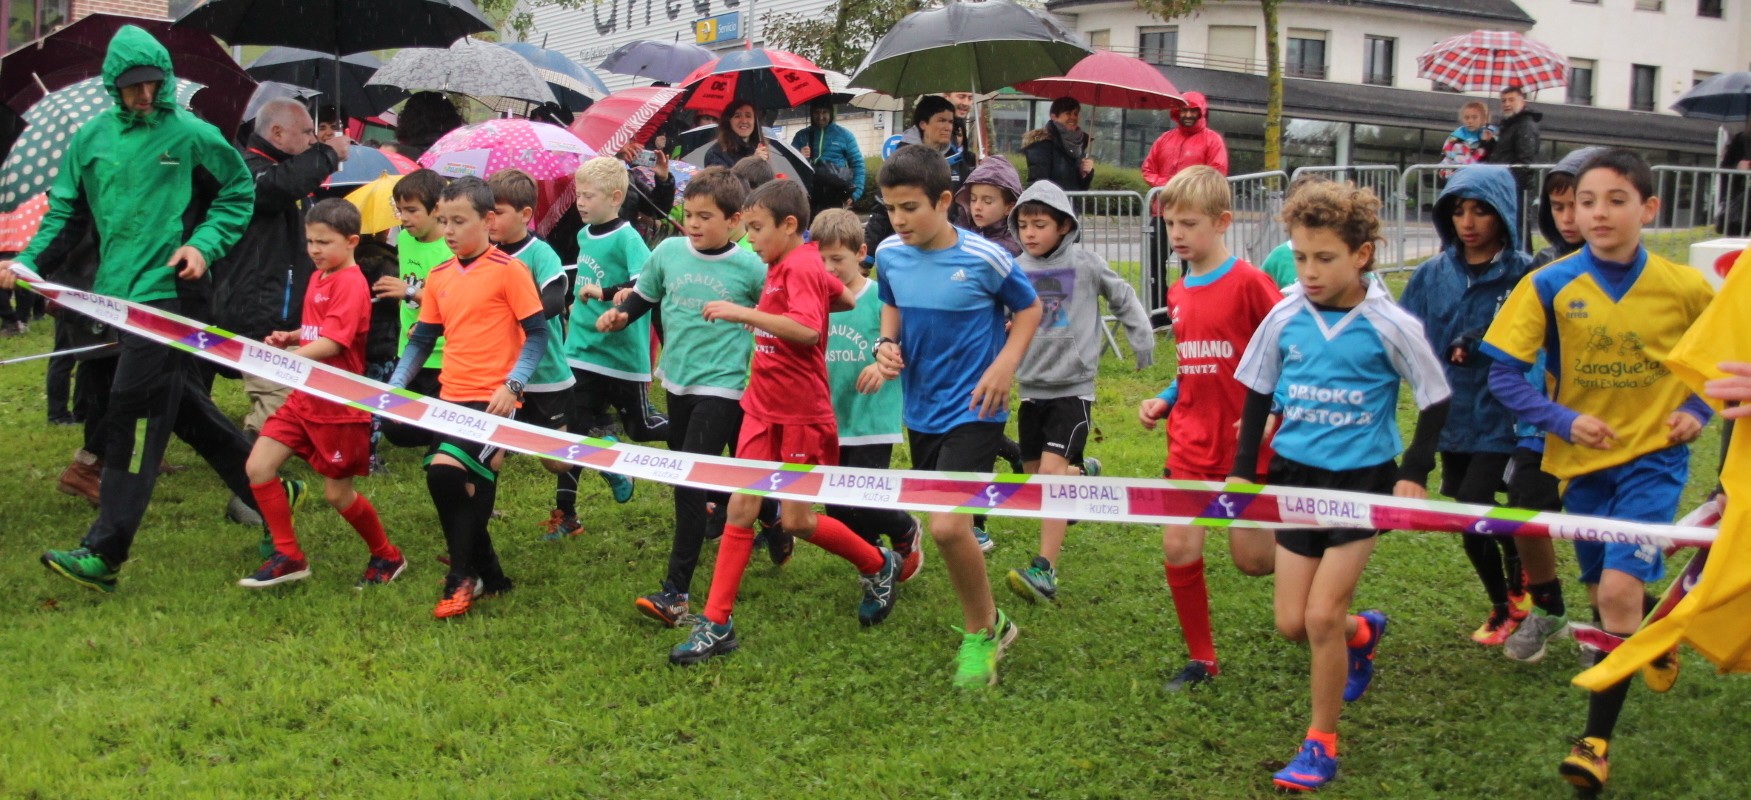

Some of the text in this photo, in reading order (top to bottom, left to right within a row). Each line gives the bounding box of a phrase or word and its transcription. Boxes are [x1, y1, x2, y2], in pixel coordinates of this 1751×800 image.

[718, 22, 737, 34] Servicio
[878, 113, 883, 123] 2
[828, 324, 868, 350] AUZKO
[248, 345, 302, 374] LABORAL
[1575, 358, 1660, 377] Zaragueta
[1288, 384, 1365, 405] ORIOKO
[431, 406, 487, 432] LABORAL
[623, 452, 683, 471] LABORAL
[828, 473, 892, 490] LABORAL
[863, 492, 890, 502] kutxa
[1049, 483, 1119, 501] LABORAL
[1089, 503, 1119, 515] kutxa
[1285, 495, 1360, 519] LABORAL
